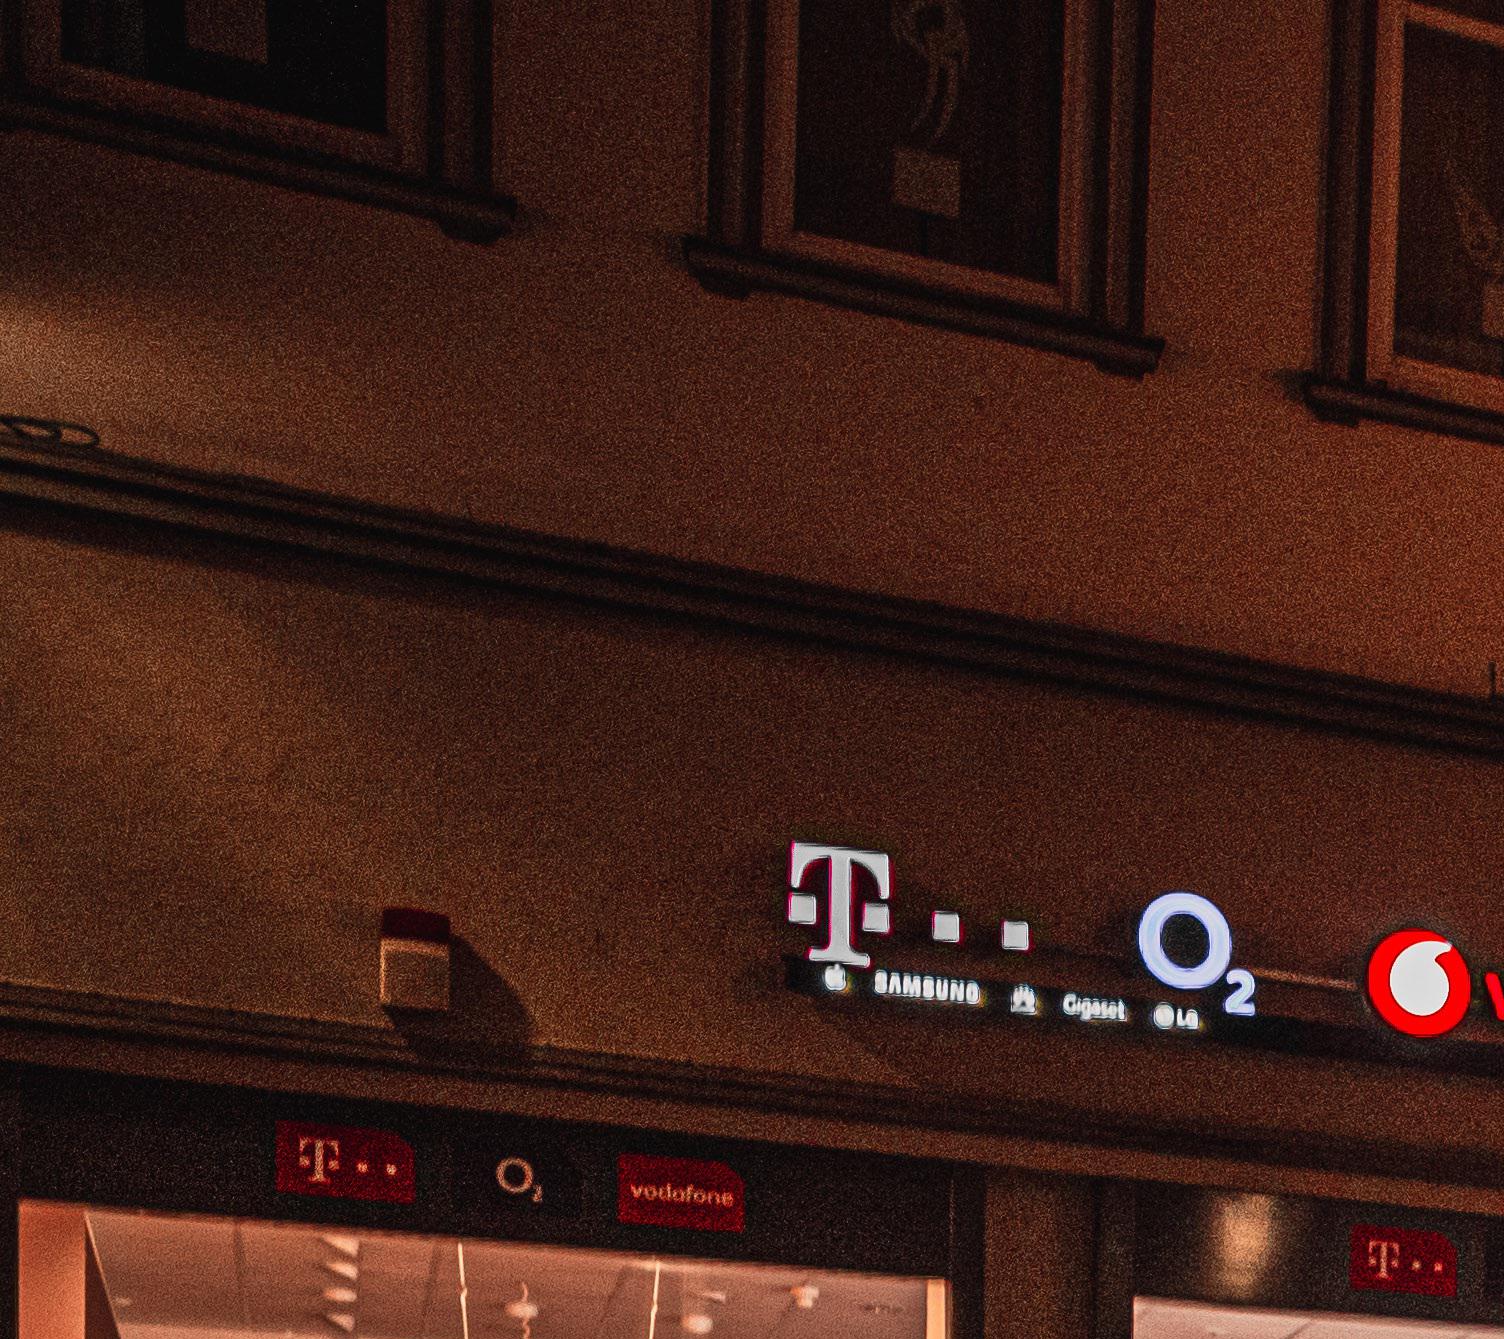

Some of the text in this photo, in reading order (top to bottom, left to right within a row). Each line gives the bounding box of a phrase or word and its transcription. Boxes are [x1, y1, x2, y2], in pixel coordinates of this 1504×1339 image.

[1138, 891, 1257, 1017] O2
[873, 967, 982, 1006] SAMSUNG
[1062, 993, 1127, 1023] Gigaset
[630, 1181, 735, 1209] vodafone
